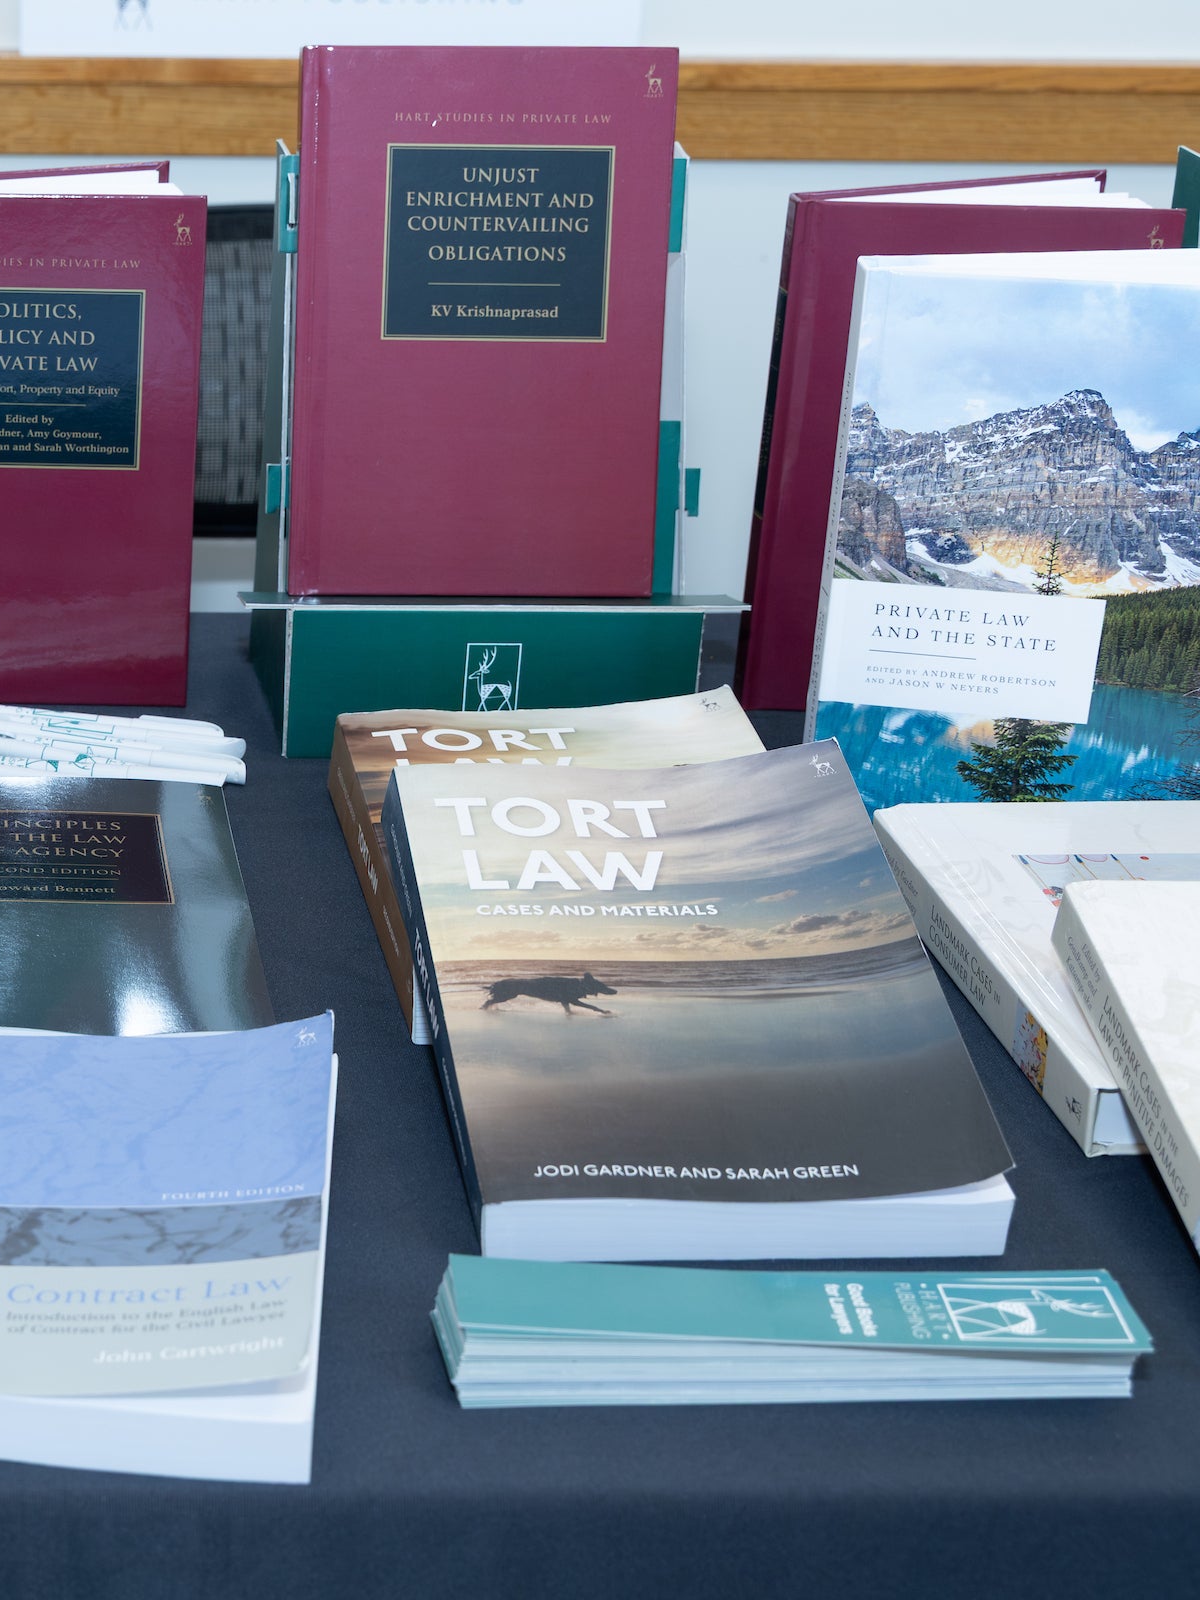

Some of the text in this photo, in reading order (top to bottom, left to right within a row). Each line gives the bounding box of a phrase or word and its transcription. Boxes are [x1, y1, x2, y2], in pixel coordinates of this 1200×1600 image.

[463, 168, 539, 186] UNJUST
[406, 191, 594, 208] ENRICHMENT AND
[407, 215, 589, 233] COUNTERVAILING
[428, 245, 566, 262] OBLIGATIONS
[431, 305, 559, 321] KV Krishnaprasad
[48, 330, 95, 346] AND
[56, 357, 98, 372] LAW
[20, 384, 62, 396] Property
[66, 385, 85, 395] and
[88, 386, 120, 397] Equity
[5, 414, 54, 426] Edited by
[27, 429, 49, 441] Amy
[53, 430, 102, 441] Goymour,
[13, 442, 31, 452] and
[34, 442, 62, 452] Sarah
[65, 443, 129, 455] Worthington
[875, 604, 1030, 627] PRIVATE LAW
[871, 625, 1056, 651] AND THE STATE
[867, 666, 901, 674] EDITED
[922, 670, 977, 680] ANDREW
[981, 674, 1056, 687] ROBERTSON
[889, 678, 930, 688] JASON
[951, 684, 999, 694] NEYERS
[371, 727, 576, 752] TORT
[434, 797, 667, 839] TORT
[10, 833, 67, 842] THE
[74, 834, 127, 844] LAW
[14, 846, 125, 858] AGENCY
[52, 867, 121, 876] EDITION
[462, 850, 663, 891] LAW
[55, 885, 116, 894] Bennett
[477, 904, 719, 916] CASES AND MATERIALS
[931, 905, 1000, 1005] LANDMARK CASES IN
[929, 925, 986, 1006] CONSUMER LAW
[414, 927, 439, 1039] TORT LAW
[1104, 995, 1178, 1158] LANDMARK CASES IN THE
[1098, 1014, 1189, 1208] LAW OF PUNITIVE DAMAGES
[534, 1164, 859, 1180] JODI GARDNER AND SARAH GREEN
[162, 1184, 304, 1200] FOURTH EDITION
[6, 1275, 291, 1305] Contract Law
[6, 1311, 116, 1322] Introduction
[121, 1312, 140, 1321] to
[146, 1310, 173, 1320] the
[178, 1304, 244, 1319] English
[250, 1299, 287, 1310] Law
[894, 1282, 931, 1339] PUBLISHING
[918, 1290, 953, 1333] HART
[92, 1336, 285, 1364] John Cartwright
